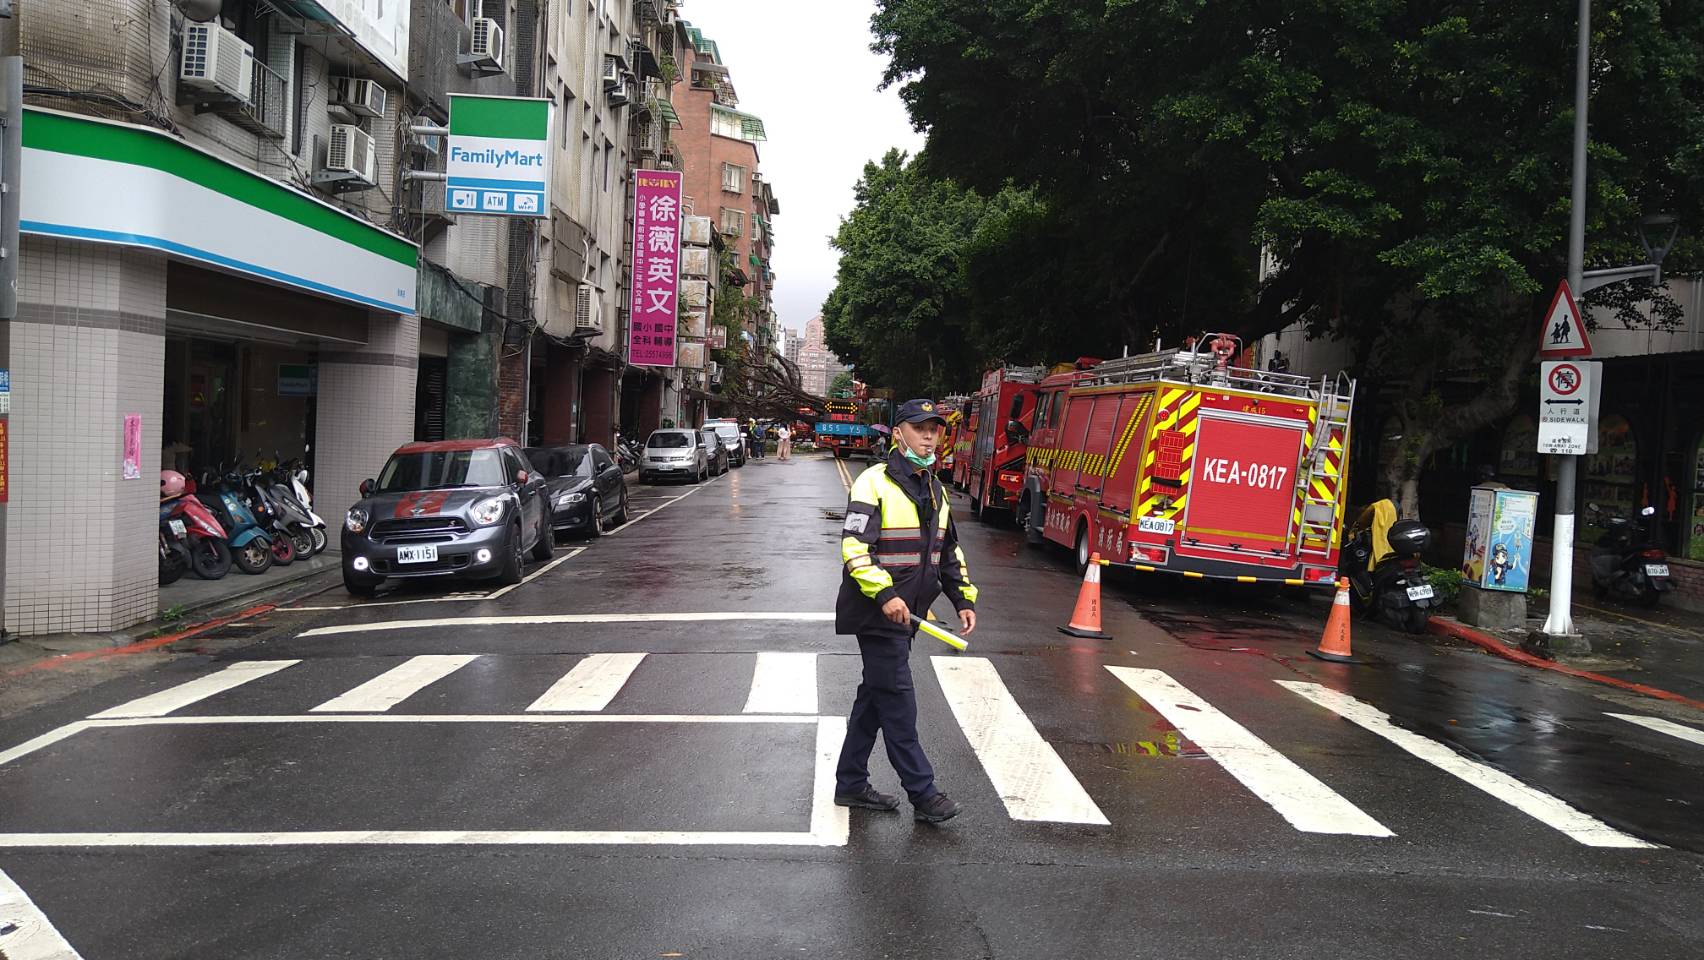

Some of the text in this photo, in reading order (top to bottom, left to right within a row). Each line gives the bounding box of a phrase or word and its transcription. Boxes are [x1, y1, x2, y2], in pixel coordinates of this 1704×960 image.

[451, 146, 542, 168] FamilyMart
[487, 196, 504, 207] ATM
[646, 195, 676, 315] 徐薇英文
[1203, 457, 1287, 490] KEA-0817
